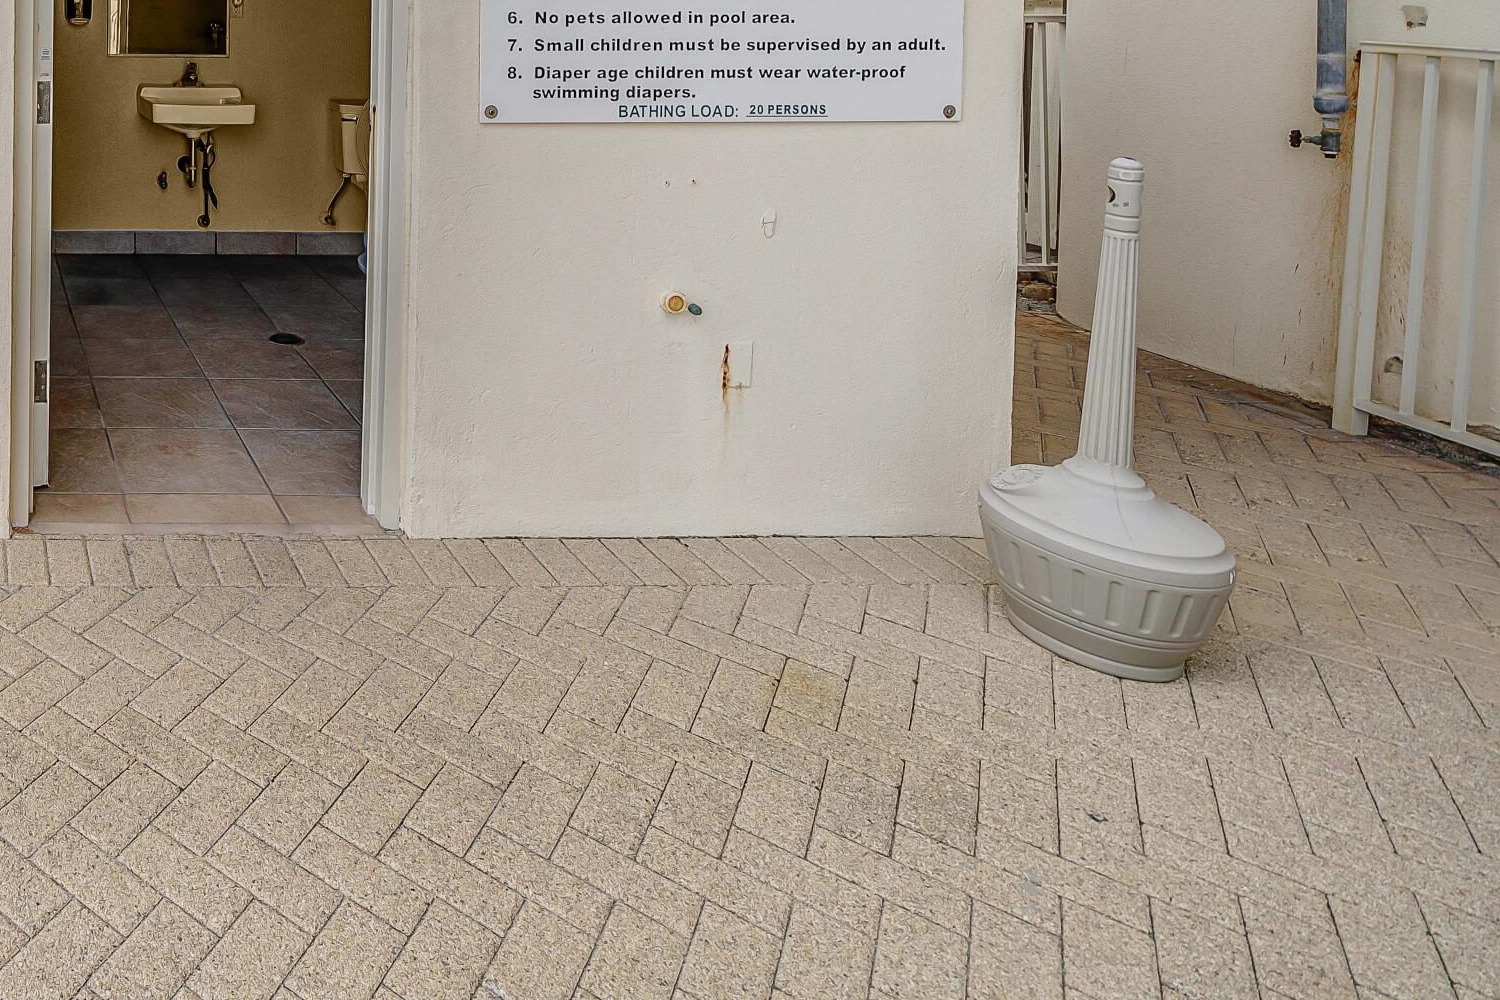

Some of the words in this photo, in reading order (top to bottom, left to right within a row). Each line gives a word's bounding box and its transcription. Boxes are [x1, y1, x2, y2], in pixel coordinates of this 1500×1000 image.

[508, 12, 522, 24] 6.
[536, 12, 558, 23] No
[566, 12, 605, 27] pets
[612, 11, 681, 23] allowed
[689, 11, 703, 23] in
[710, 11, 745, 26] pool
[752, 14, 794, 23] area.
[508, 39, 522, 51] 7.
[534, 39, 583, 51] Small
[591, 39, 662, 51] children
[670, 39, 714, 50] must
[721, 39, 740, 50] be
[747, 39, 840, 54] supervised
[847, 39, 866, 54] by
[872, 42, 891, 50] an
[898, 38, 945, 50] adult.
[508, 67, 522, 79] 8.
[535, 67, 591, 82] Diaper
[597, 70, 628, 82] age
[635, 66, 703, 78] children
[711, 67, 752, 78] must
[759, 69, 801, 78] wear
[807, 66, 906, 81] water-proof
[533, 86, 619, 101] swimming
[626, 86, 695, 101] diapers.
[619, 105, 685, 117] BATHING
[692, 105, 738, 117] LOAD:
[750, 105, 763, 114] 20
[768, 105, 825, 114] PERSONS
